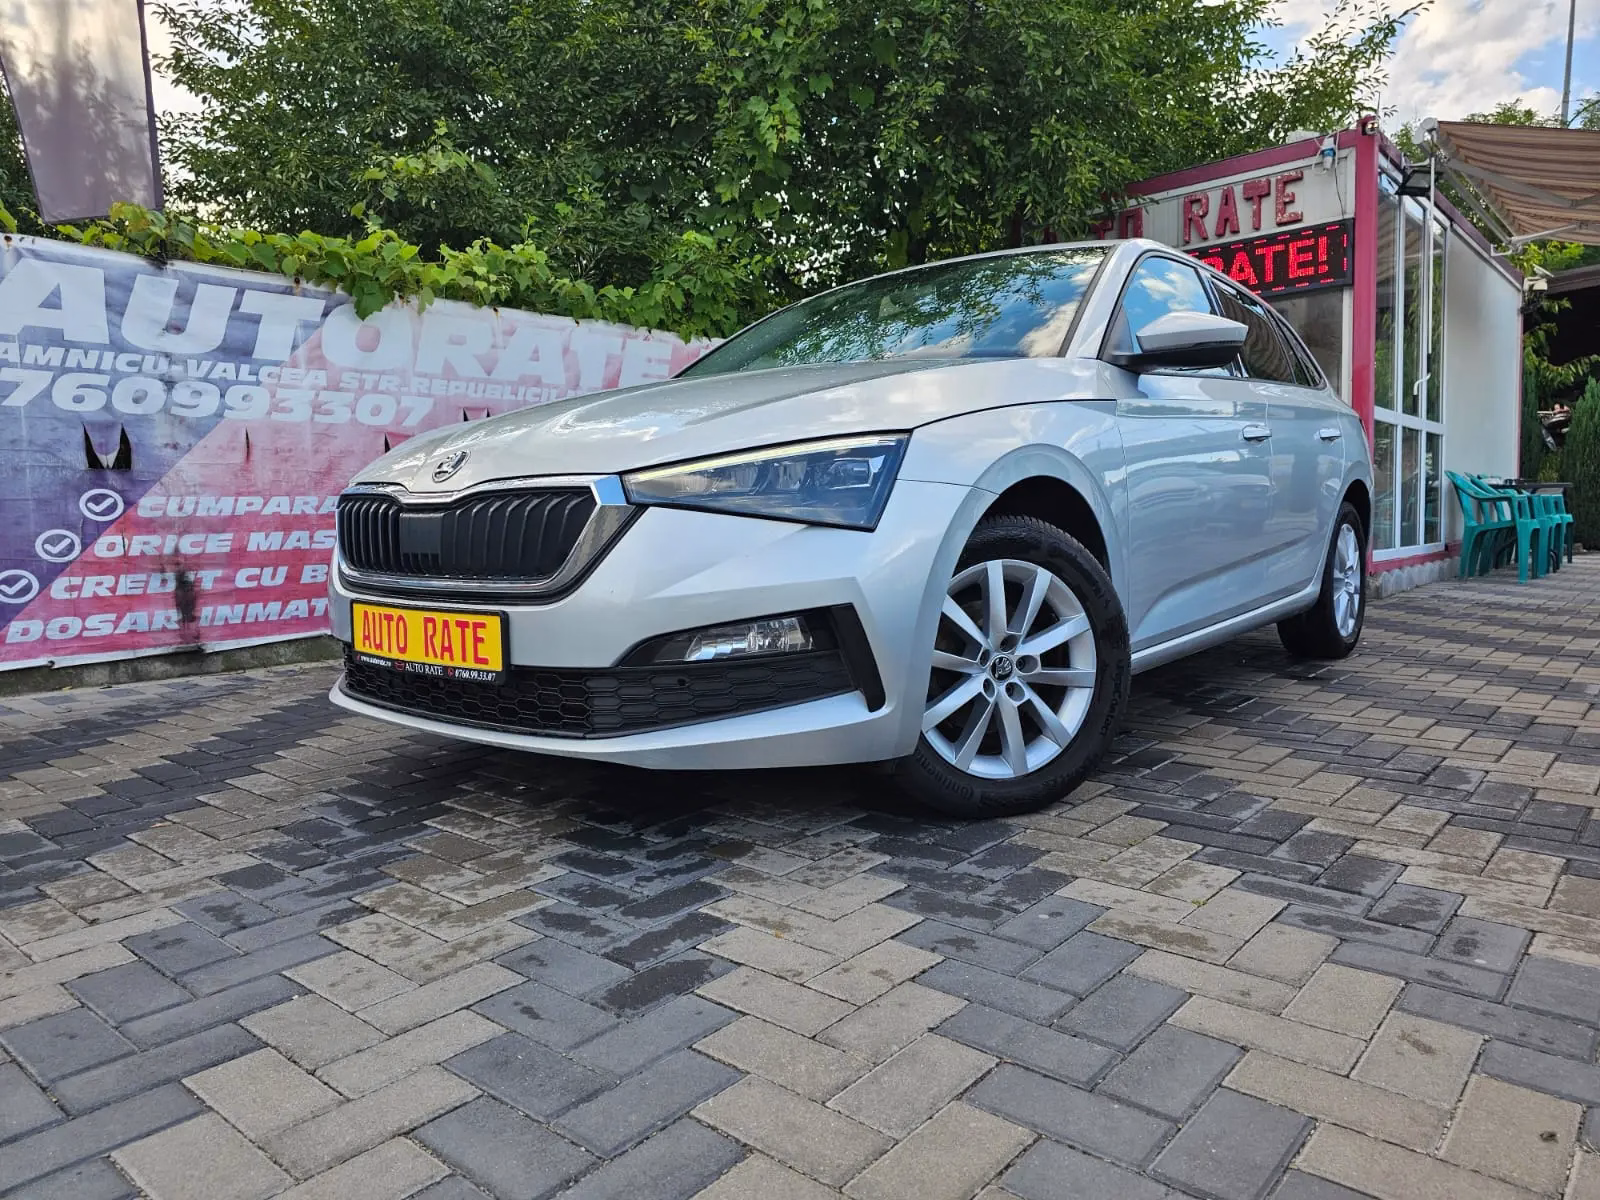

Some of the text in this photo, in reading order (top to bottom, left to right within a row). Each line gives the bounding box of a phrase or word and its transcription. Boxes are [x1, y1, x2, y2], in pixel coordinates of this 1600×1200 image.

[1183, 170, 1304, 244] RATE
[0, 258, 672, 391] AUTORATE
[0, 367, 434, 427] 760993307
[93, 529, 337, 557] ORICE MAS
[235, 566, 288, 588] CU
[301, 564, 329, 584] B
[5, 610, 181, 644] DOSAR
[361, 609, 489, 666] AUTO RATE
[405, 662, 444, 676] AUTO RATE
